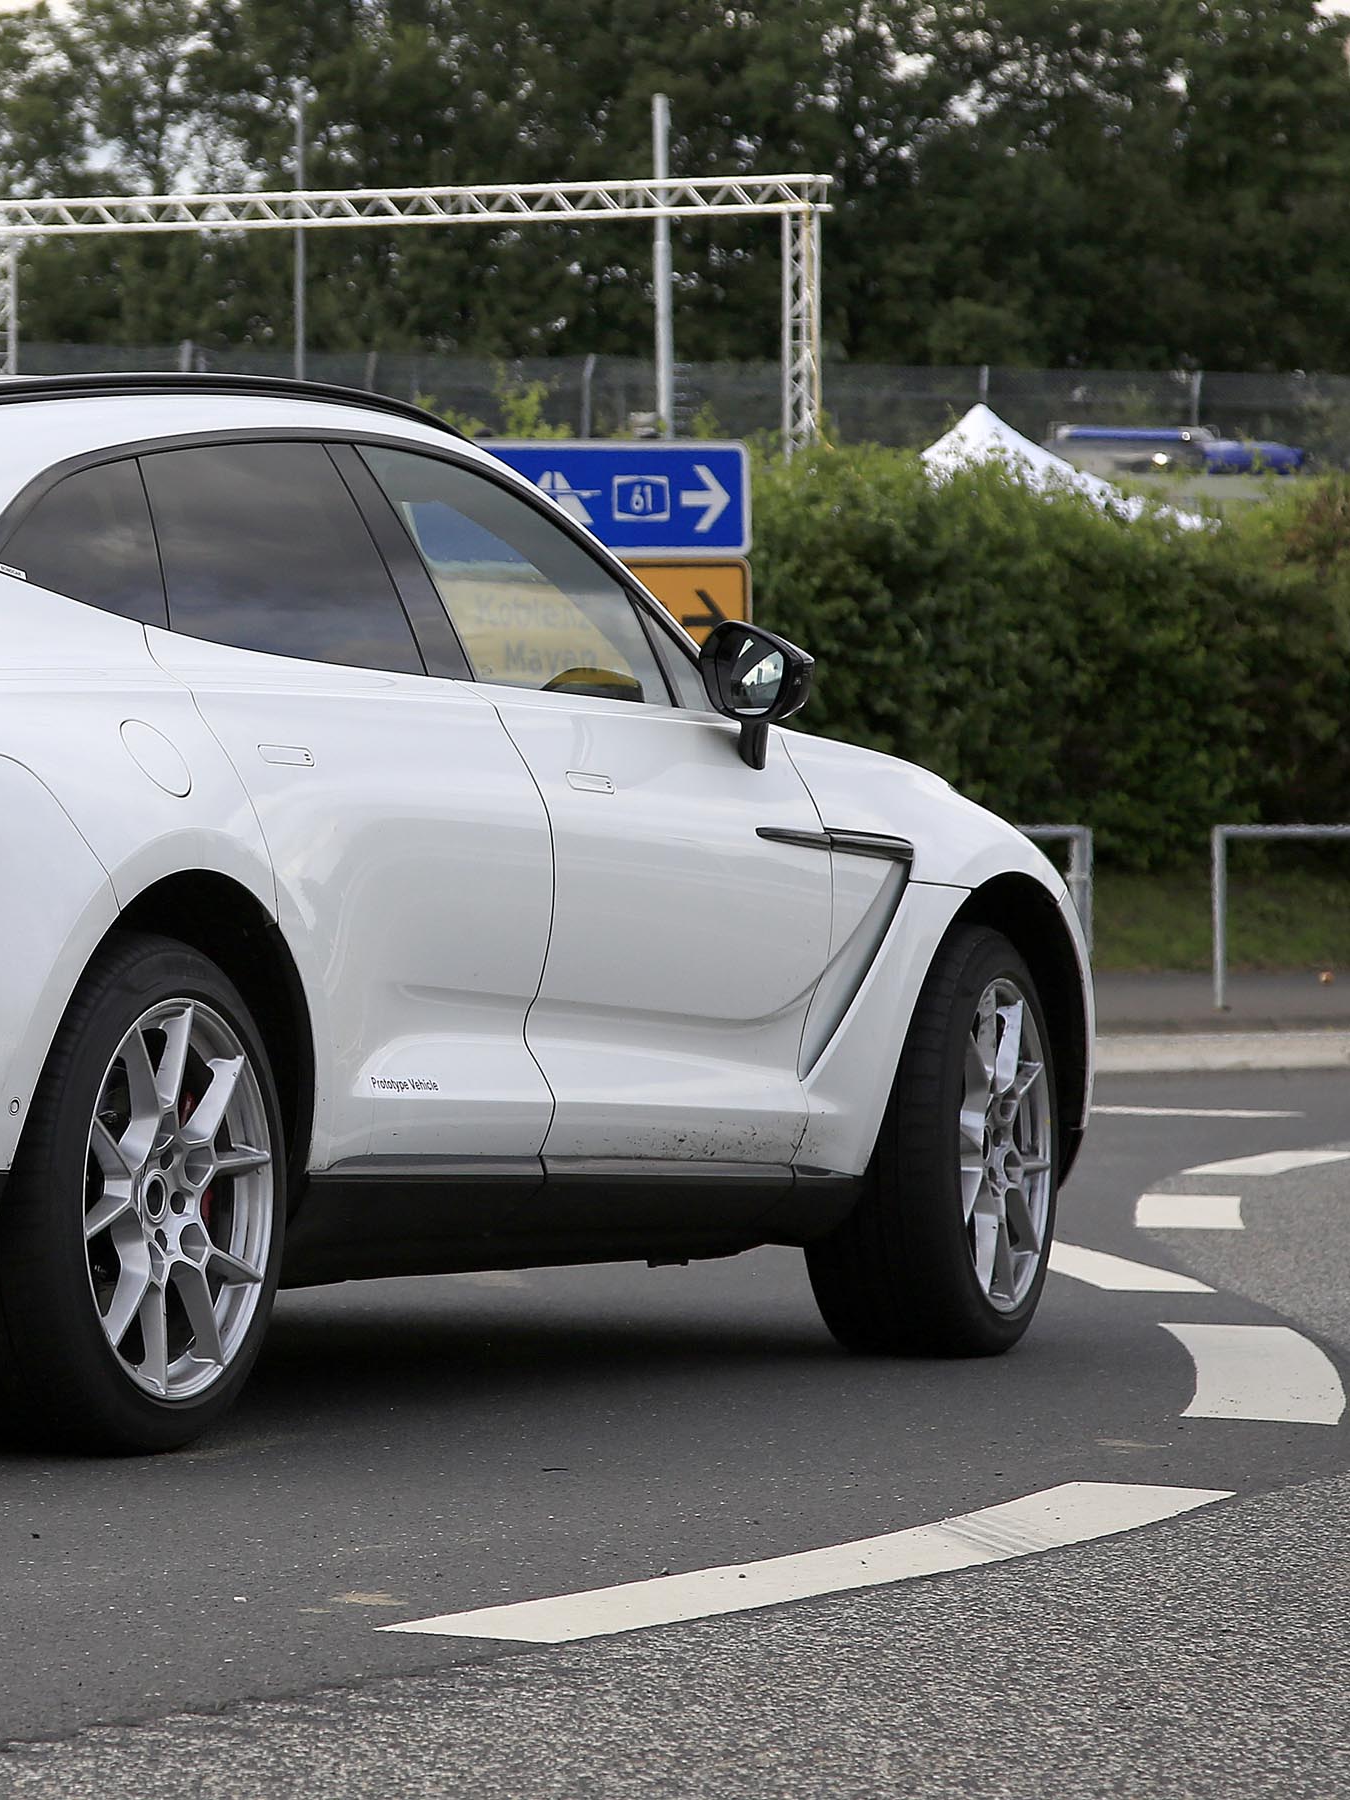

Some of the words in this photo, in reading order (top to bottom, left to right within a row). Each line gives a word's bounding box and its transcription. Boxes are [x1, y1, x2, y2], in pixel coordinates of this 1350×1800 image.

[630, 484, 652, 512] 61
[504, 639, 598, 674] Mayen
[371, 1076, 410, 1092] Prototype
[408, 1079, 439, 1091] Vehicle
